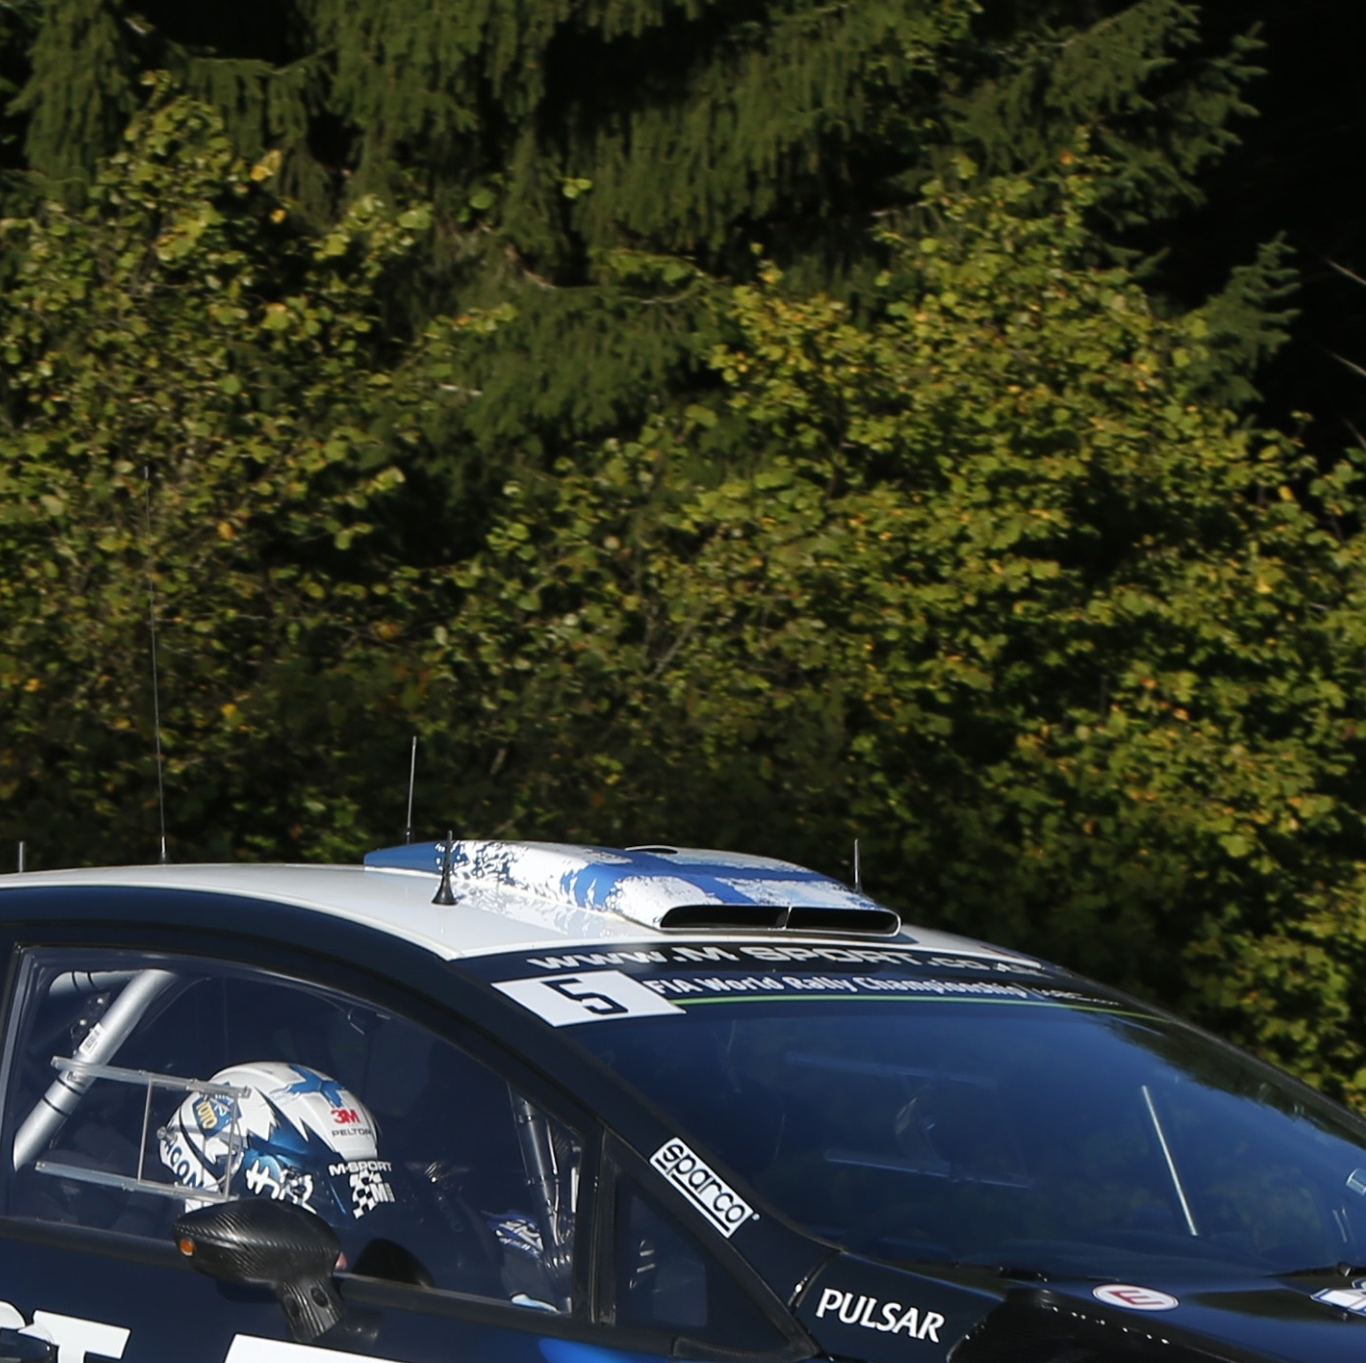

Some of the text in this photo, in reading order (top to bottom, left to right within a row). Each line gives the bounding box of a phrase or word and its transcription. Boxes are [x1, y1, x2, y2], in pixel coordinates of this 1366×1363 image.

[539, 977, 629, 1015] 5
[641, 979, 703, 996] FIA
[695, 976, 782, 993] World
[781, 975, 858, 993] Rally
[851, 975, 1028, 999] Championship
[331, 1109, 361, 1124] 3M
[328, 1160, 392, 1177] M-SPORT
[661, 1143, 746, 1225] sparco
[815, 1288, 946, 1343] PULSAR
